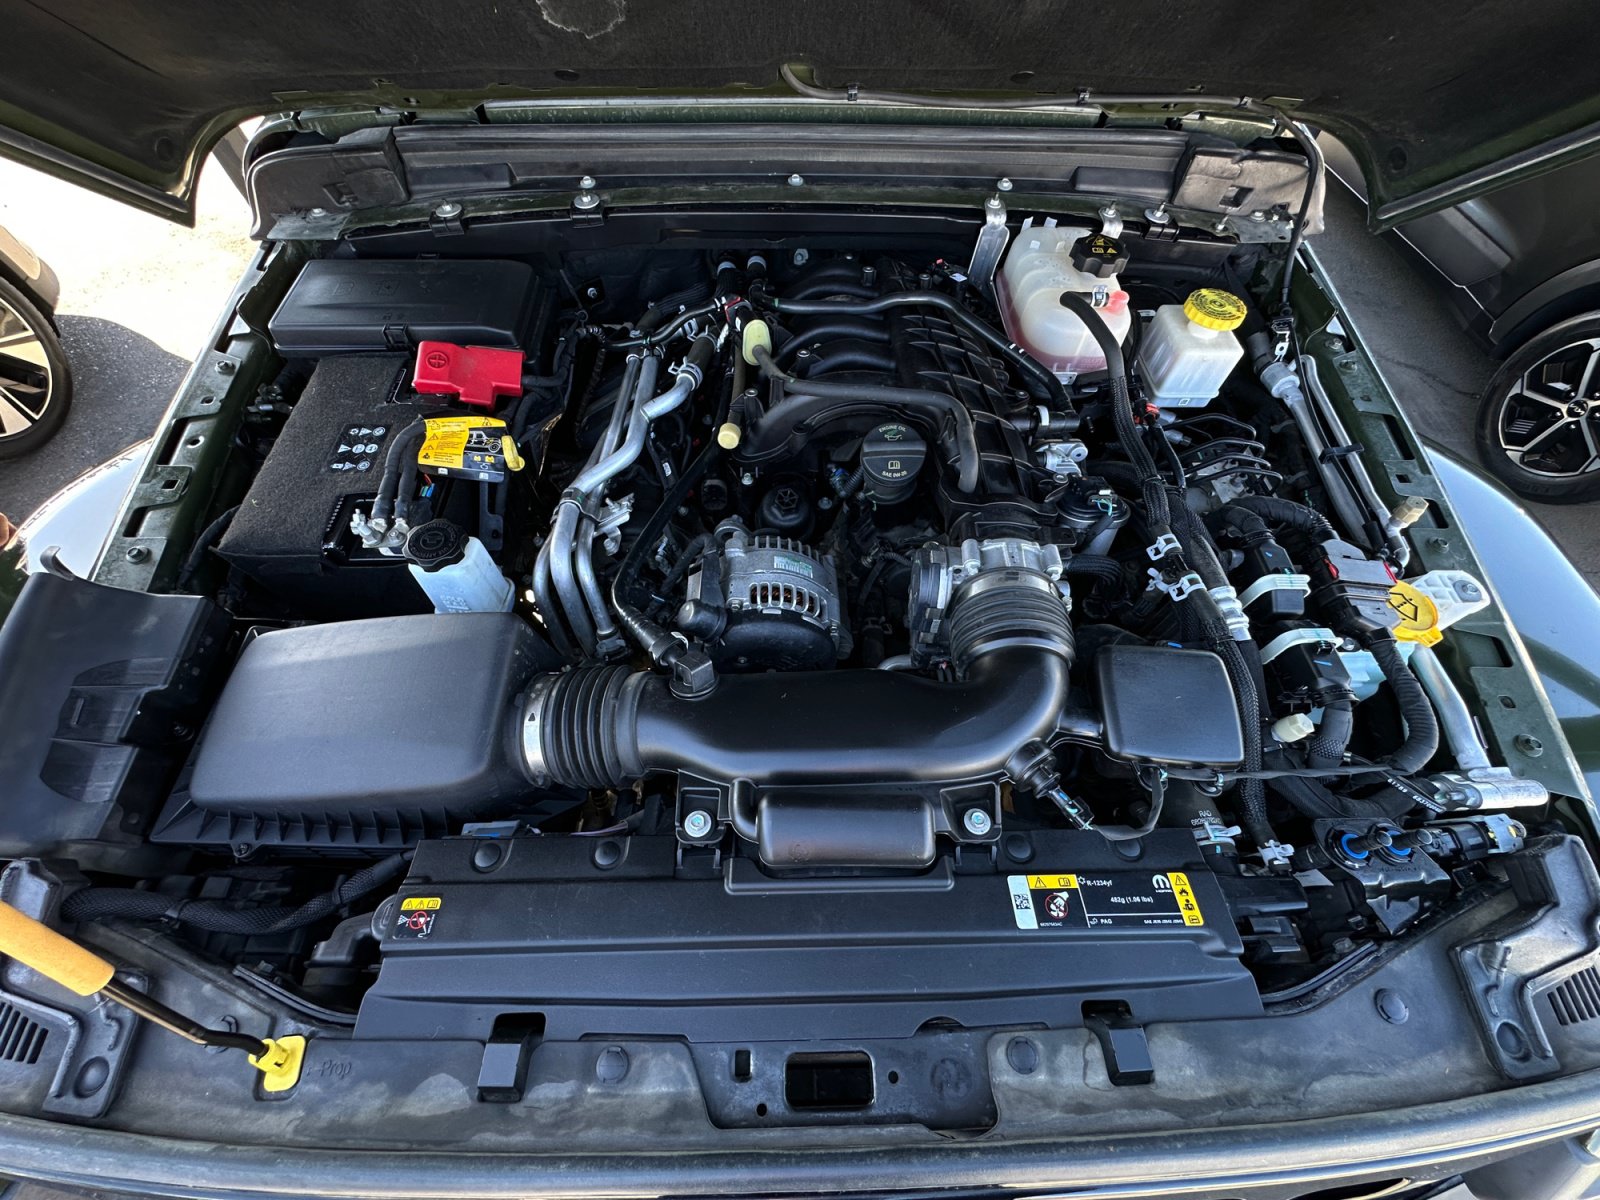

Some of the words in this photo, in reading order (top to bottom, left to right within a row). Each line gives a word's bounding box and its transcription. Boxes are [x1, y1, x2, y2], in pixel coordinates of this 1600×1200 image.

[879, 425, 898, 433] ENGINE
[882, 470, 892, 478] SAE
[1110, 896, 1126, 904] 482g
